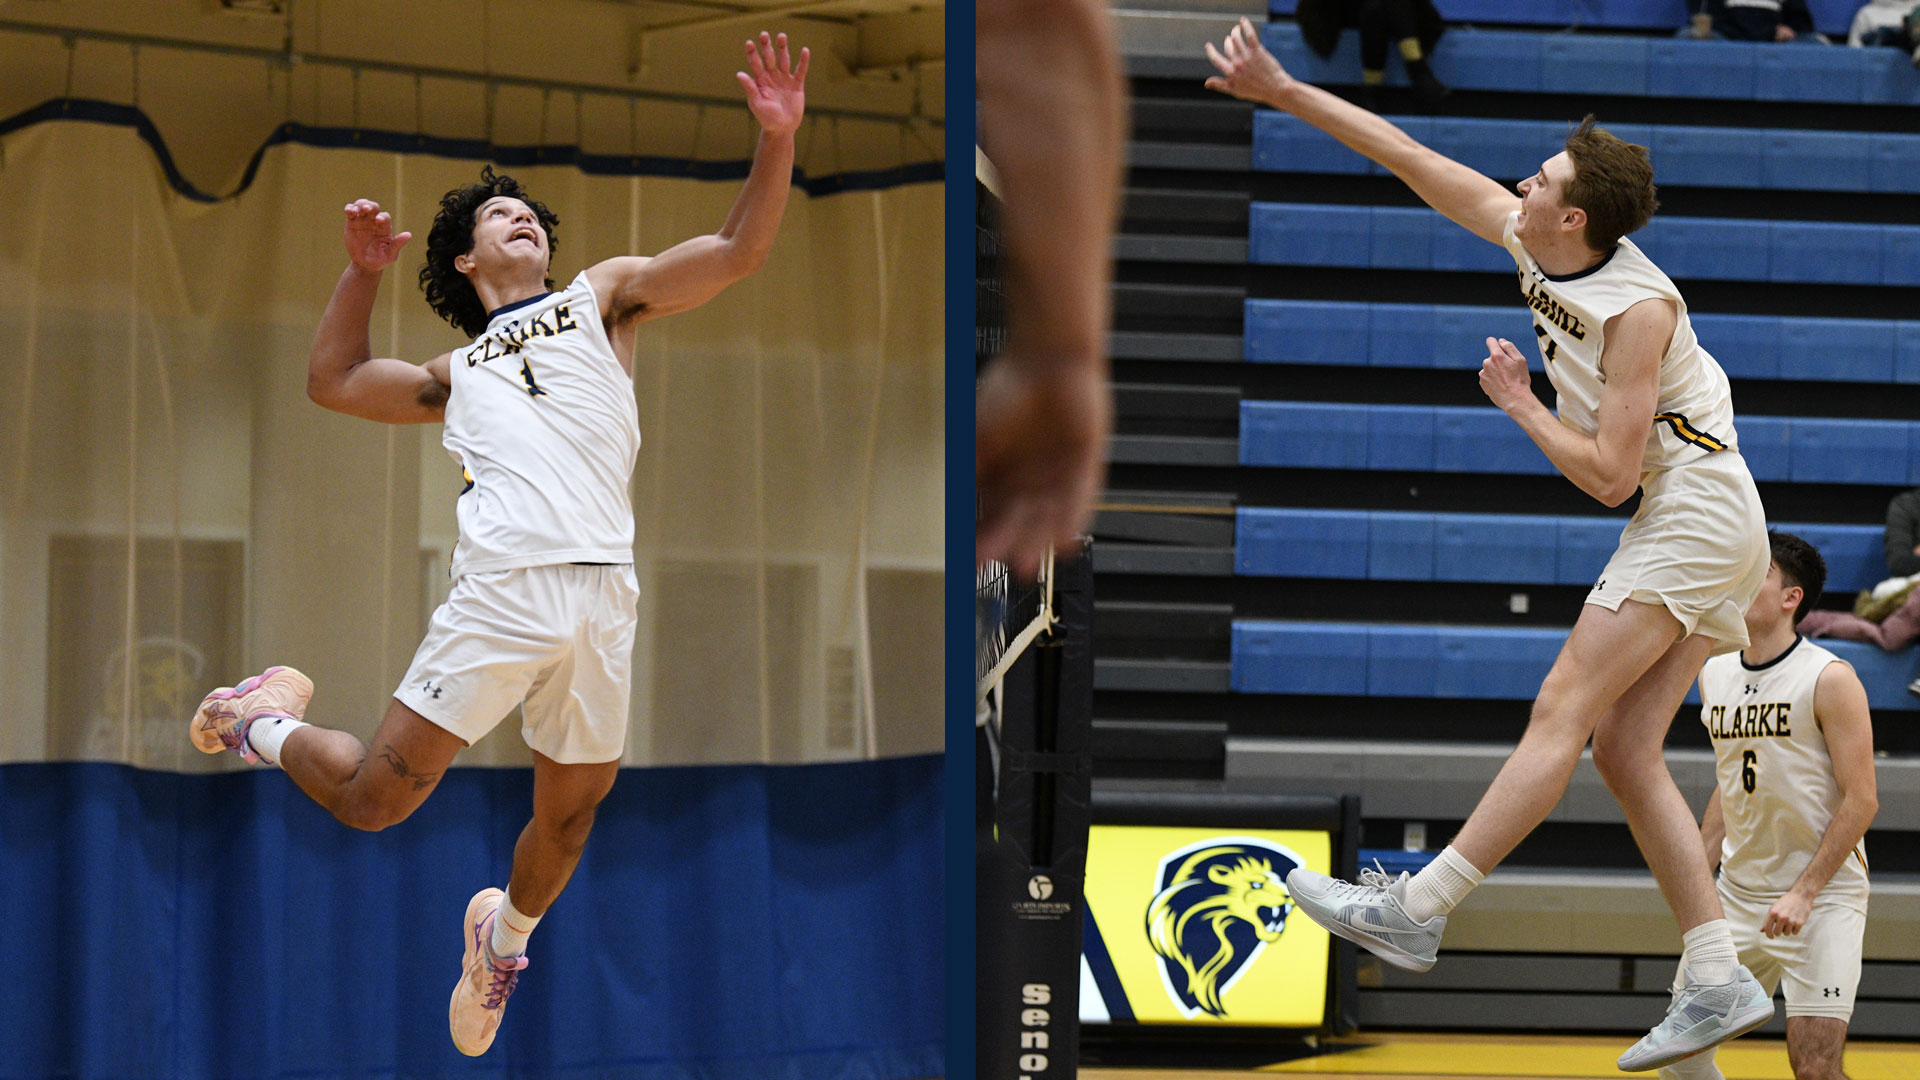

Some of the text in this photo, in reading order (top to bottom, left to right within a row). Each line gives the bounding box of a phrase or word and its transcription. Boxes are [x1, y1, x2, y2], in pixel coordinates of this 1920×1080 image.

[520, 356, 548, 397] 1
[1710, 702, 1792, 739] CLARKE
[1742, 749, 1757, 795] 6
[1019, 983, 1051, 1080] Seno
